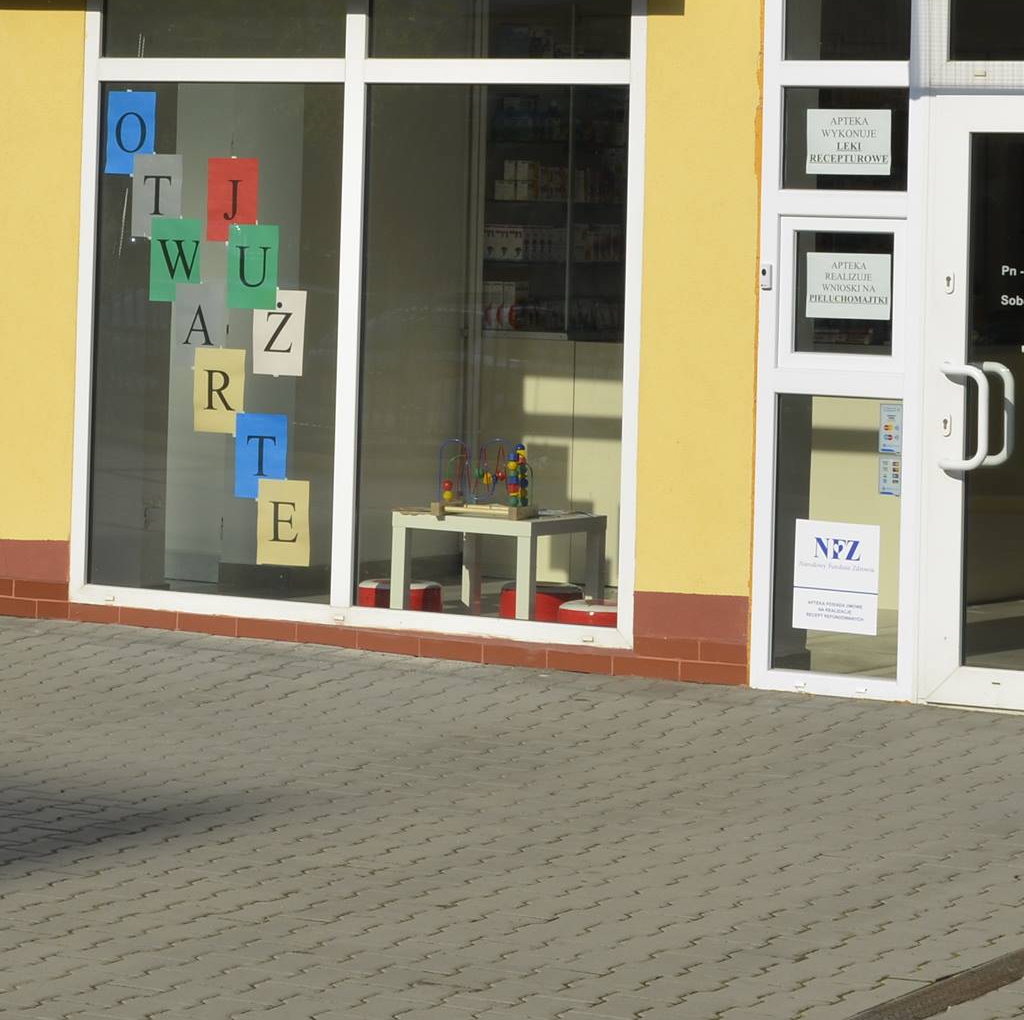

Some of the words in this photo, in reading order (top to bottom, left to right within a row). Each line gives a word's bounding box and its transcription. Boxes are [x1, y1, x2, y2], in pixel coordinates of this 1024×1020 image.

[830, 116, 869, 126] APTEKA
[821, 128, 877, 138] WYKONUJE
[836, 141, 862, 151] LEKI
[809, 153, 889, 164] RECEPTUROWE
[831, 261, 867, 270] APTEKA
[1001, 265, 1017, 276] Pn
[824, 272, 873, 282] REALIZUJE
[822, 283, 861, 293] WNIOSKI
[862, 284, 876, 293] NA
[814, 536, 862, 561] NFZ
